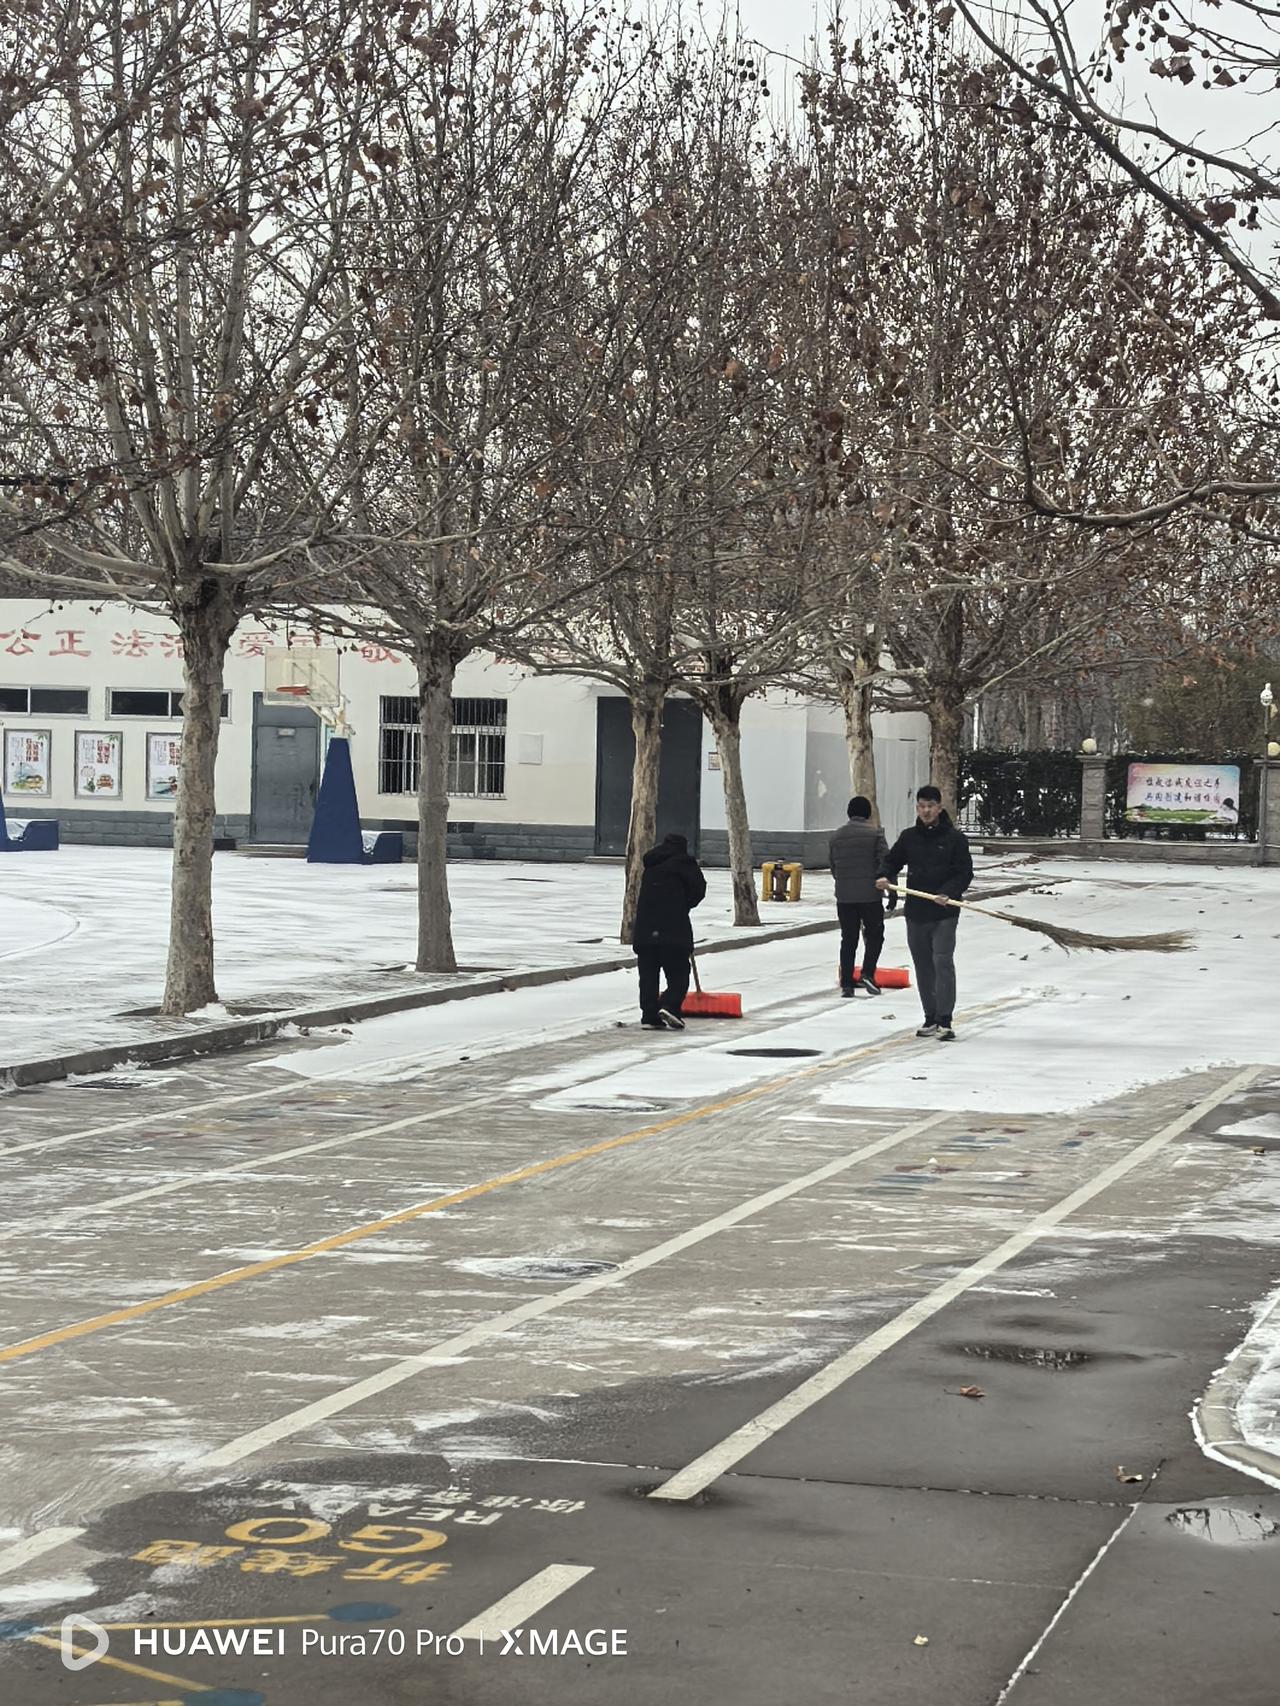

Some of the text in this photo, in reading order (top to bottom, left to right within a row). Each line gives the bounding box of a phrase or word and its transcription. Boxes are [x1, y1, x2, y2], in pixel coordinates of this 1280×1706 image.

[0, 629, 92, 657] 公正
[224, 1517, 448, 1554] GO
[130, 1539, 453, 1584] 折线跑
